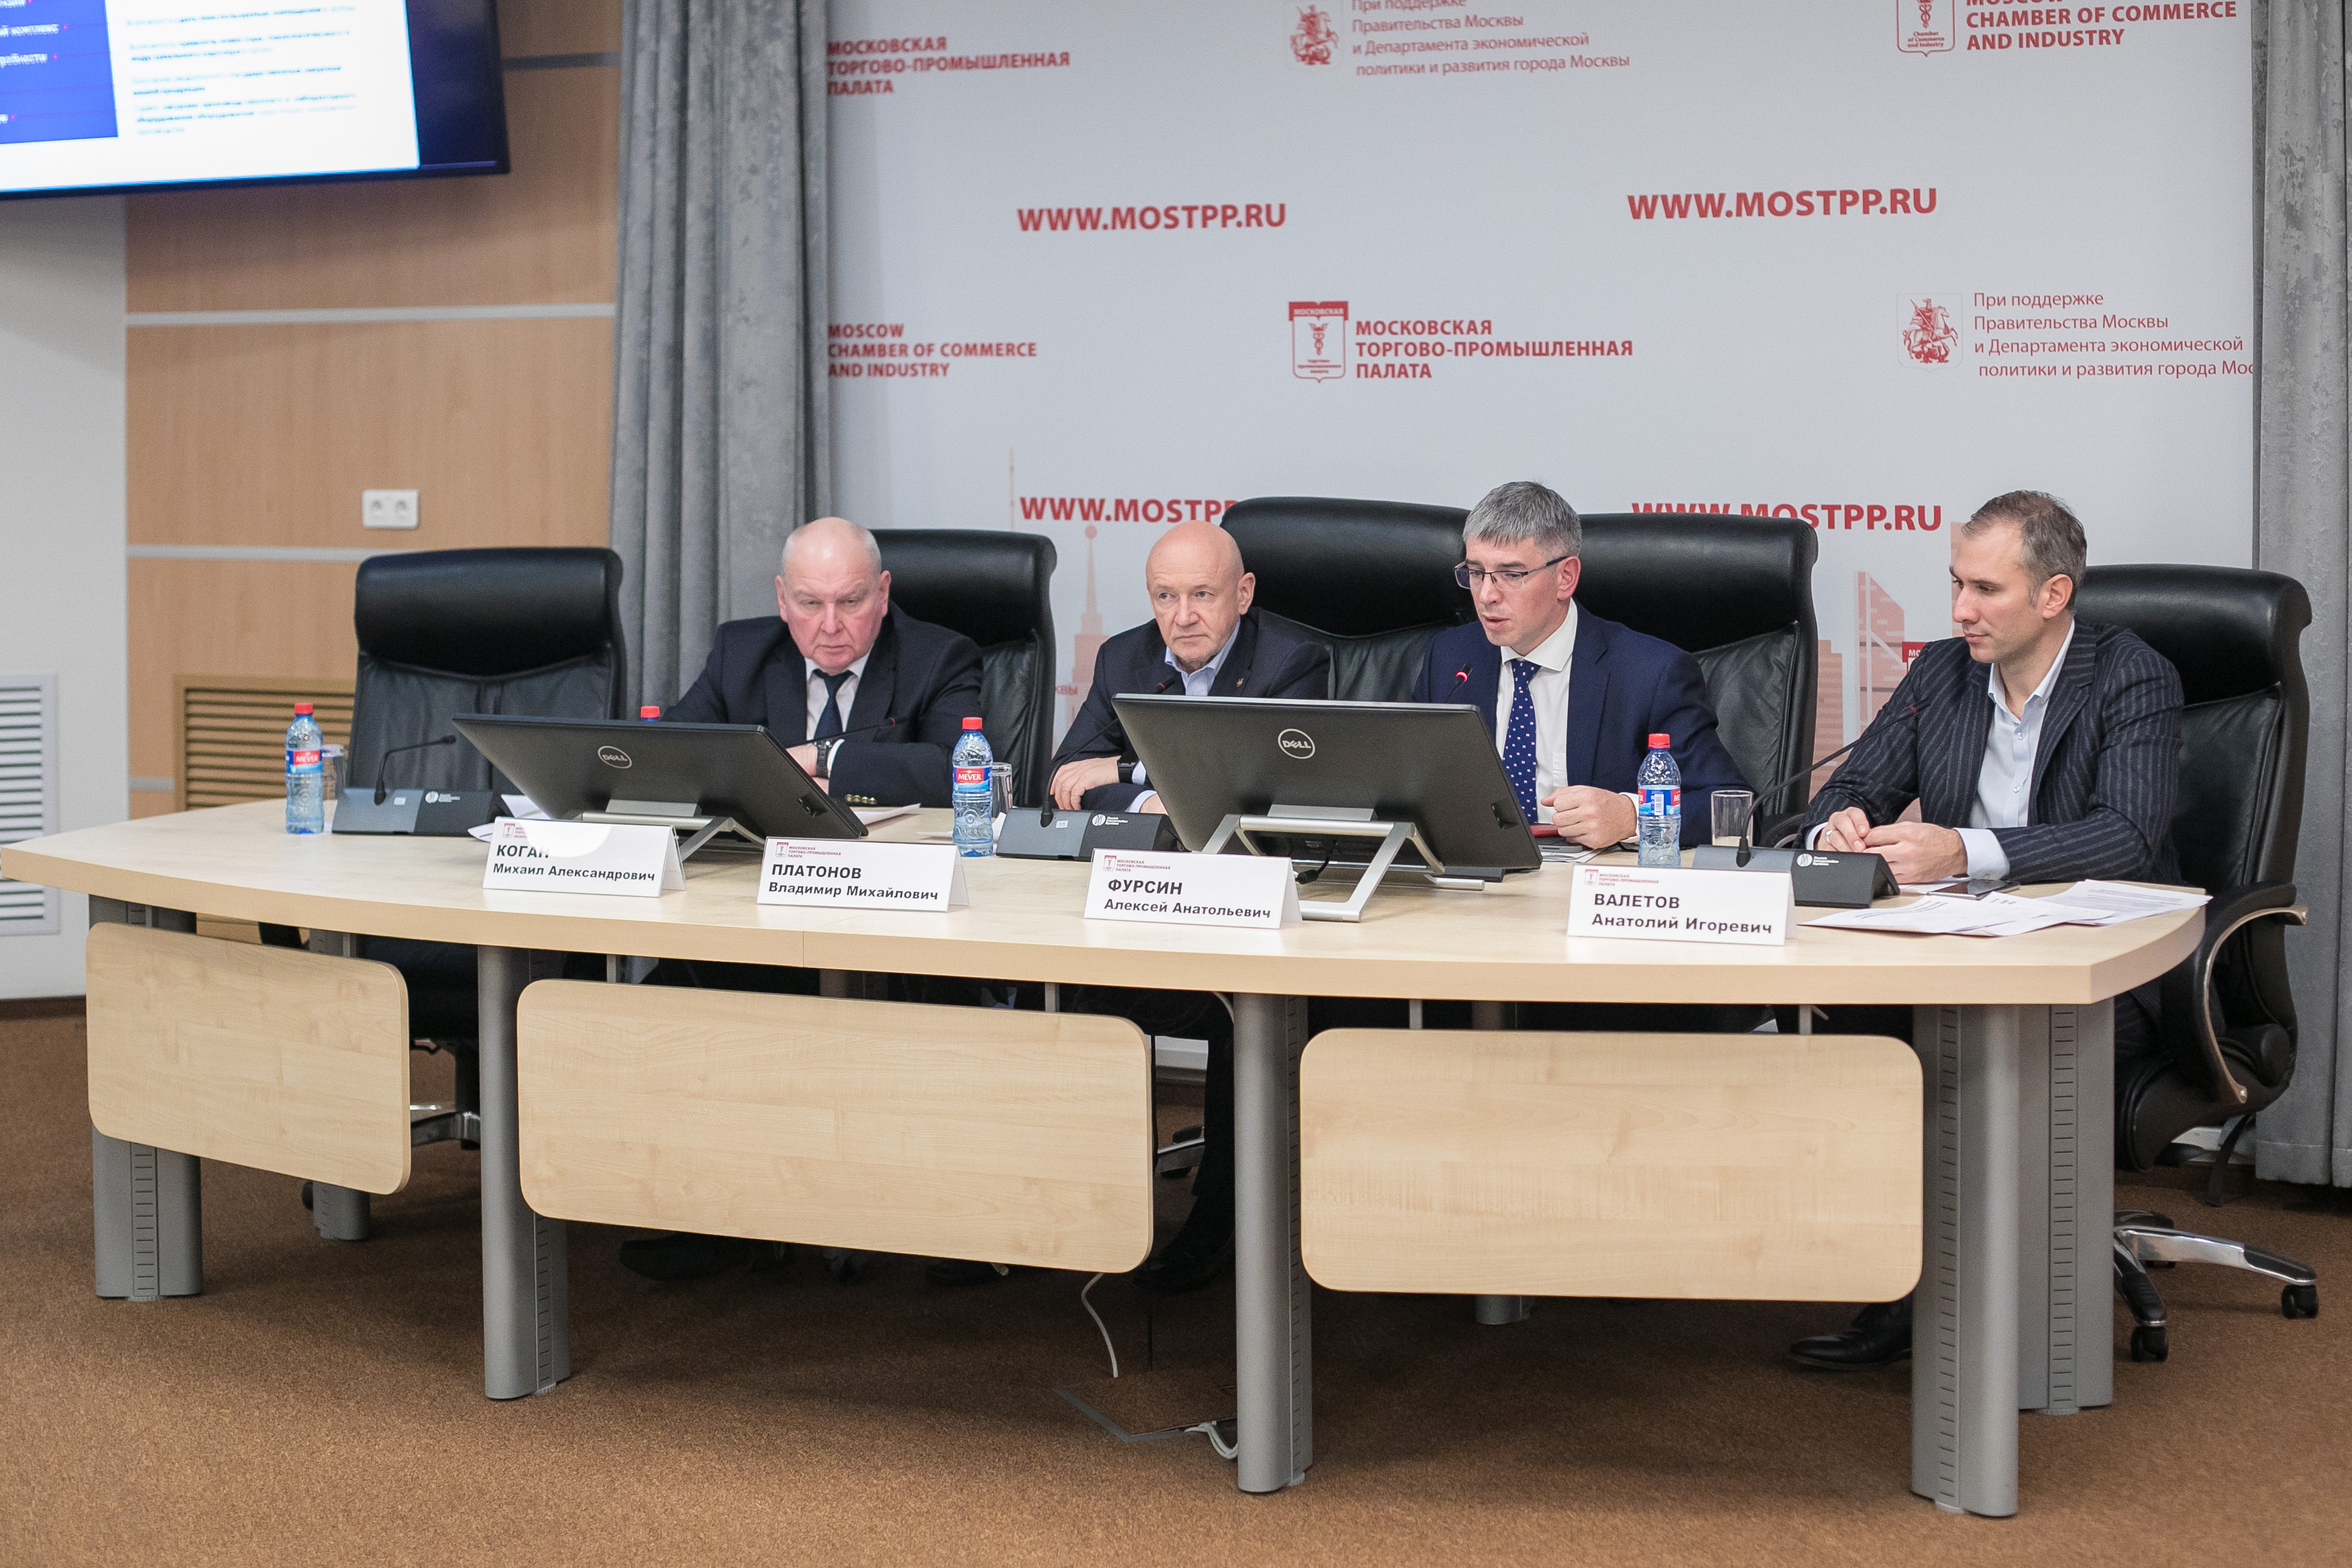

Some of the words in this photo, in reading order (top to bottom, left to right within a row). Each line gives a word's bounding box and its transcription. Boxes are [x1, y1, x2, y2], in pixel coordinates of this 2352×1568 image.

[1966, 8, 2071, 28] CHAMBER
[2077, 7, 2105, 24] OF
[2112, 1, 2237, 22] COMMERCE
[1353, 17, 1461, 35] Правительства
[1464, 15, 1524, 28] Москвы
[827, 37, 947, 56] МОСКОВСКАЯ
[1353, 44, 1362, 54] и
[1365, 40, 1468, 57] Департамента
[1473, 32, 1590, 51] экономической
[1967, 33, 2012, 51] AND
[2019, 29, 2125, 49] INDUSTRY
[828, 52, 1070, 76] ТОРГОВО-ПРОМЫШЛЕННАЯ
[1356, 64, 1426, 76] политики
[1429, 63, 1438, 74] и
[1442, 61, 1509, 76] развития
[1514, 58, 1566, 72] города
[1570, 55, 1630, 69] Москвы
[828, 80, 894, 95] ПАЛАТА
[1627, 188, 1936, 220] WWW.MOSTPP.RU
[1017, 204, 1286, 232] WWW.MOSTPP.RU
[1974, 293, 2006, 309] При
[2010, 294, 2104, 308] поддержке
[828, 323, 904, 338] MOSCOW
[1356, 319, 1492, 335] МОСКОВСКАЯ
[1974, 316, 2097, 332] Правительства
[2102, 314, 2169, 329] Москвы
[828, 343, 909, 358] CHAMBER
[913, 343, 935, 357] OF
[940, 342, 1037, 357] COMMERCE
[1356, 340, 1633, 358] ТОРГОВО-ПРОМЫШЛЕННАЯ
[1974, 343, 1984, 353] и
[1988, 339, 2106, 356] Департамента
[2111, 336, 2243, 352] экономической
[829, 363, 863, 377] AND
[867, 363, 950, 377] INDUSTRY
[1356, 363, 1432, 379] ПАЛАТА
[1979, 366, 2057, 377] политики
[2062, 366, 2071, 376] и
[2076, 364, 2152, 380] развития
[2157, 364, 2216, 378] города
[1282, 740, 1311, 749] DELL
[493, 863, 545, 876] Михаил
[548, 866, 655, 882] Александрович
[772, 864, 862, 879] ПЛАТОНОВ
[769, 882, 842, 898] Владимир
[847, 886, 938, 900] Михайлович
[1108, 879, 1183, 895] ФУРСИН
[1104, 899, 1167, 912] Алексей
[1172, 902, 1271, 918] Анатольевич
[1594, 893, 1679, 909] ВАЛЕТОВ
[1592, 914, 1678, 929] Анатолий
[1686, 917, 1772, 934] Игоревич
